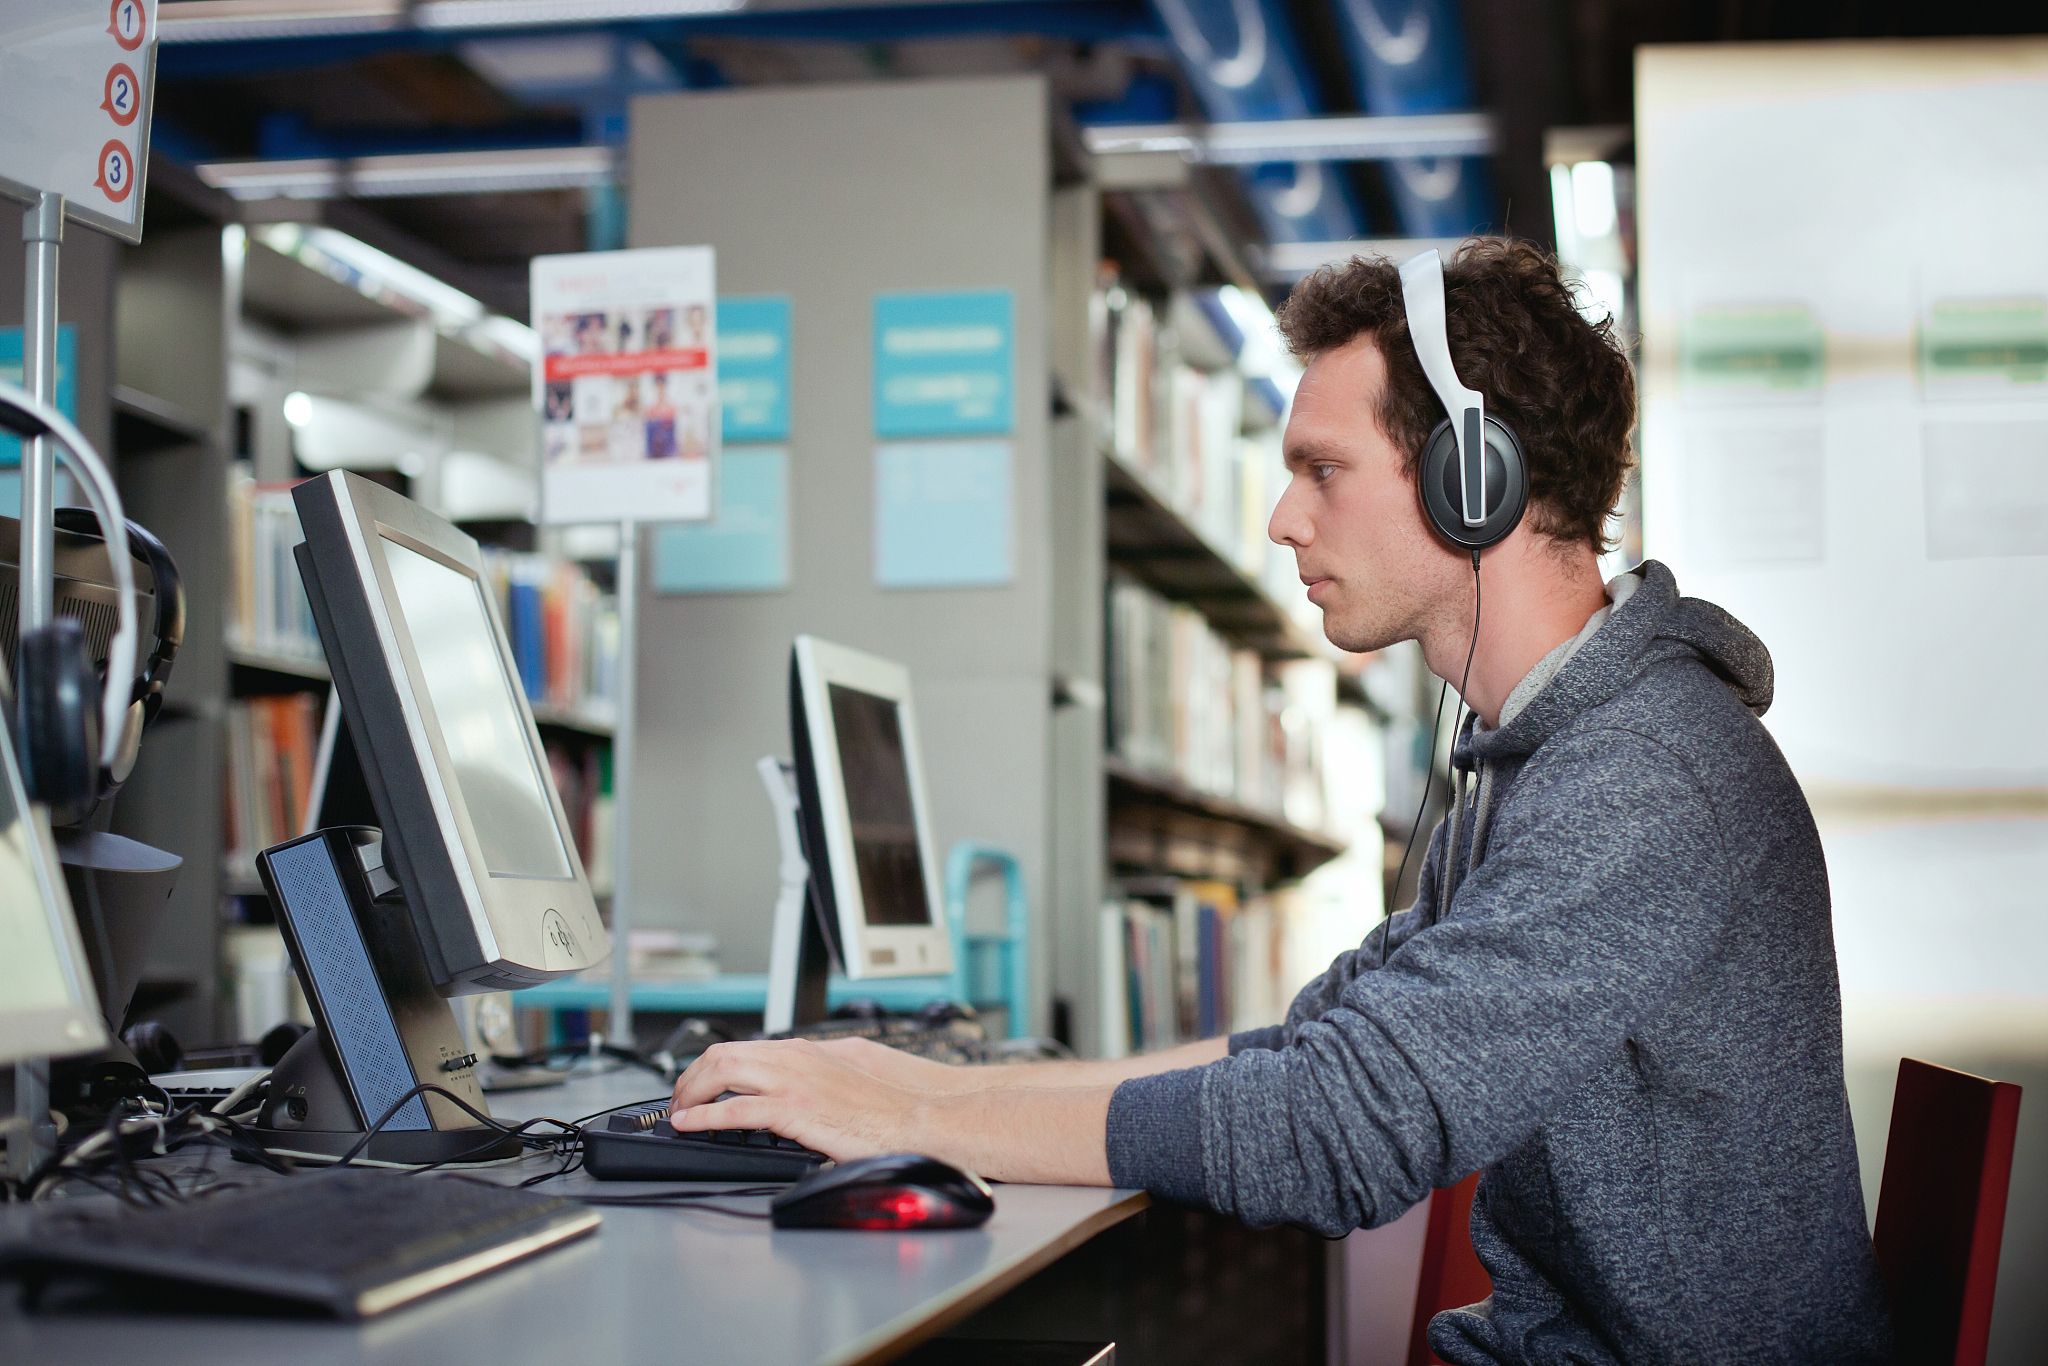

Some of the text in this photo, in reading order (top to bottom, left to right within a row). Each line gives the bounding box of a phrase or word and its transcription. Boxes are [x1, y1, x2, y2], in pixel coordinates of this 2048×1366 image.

[123, 5, 132, 32] 1
[115, 79, 128, 109] 2
[109, 155, 121, 184] 3
